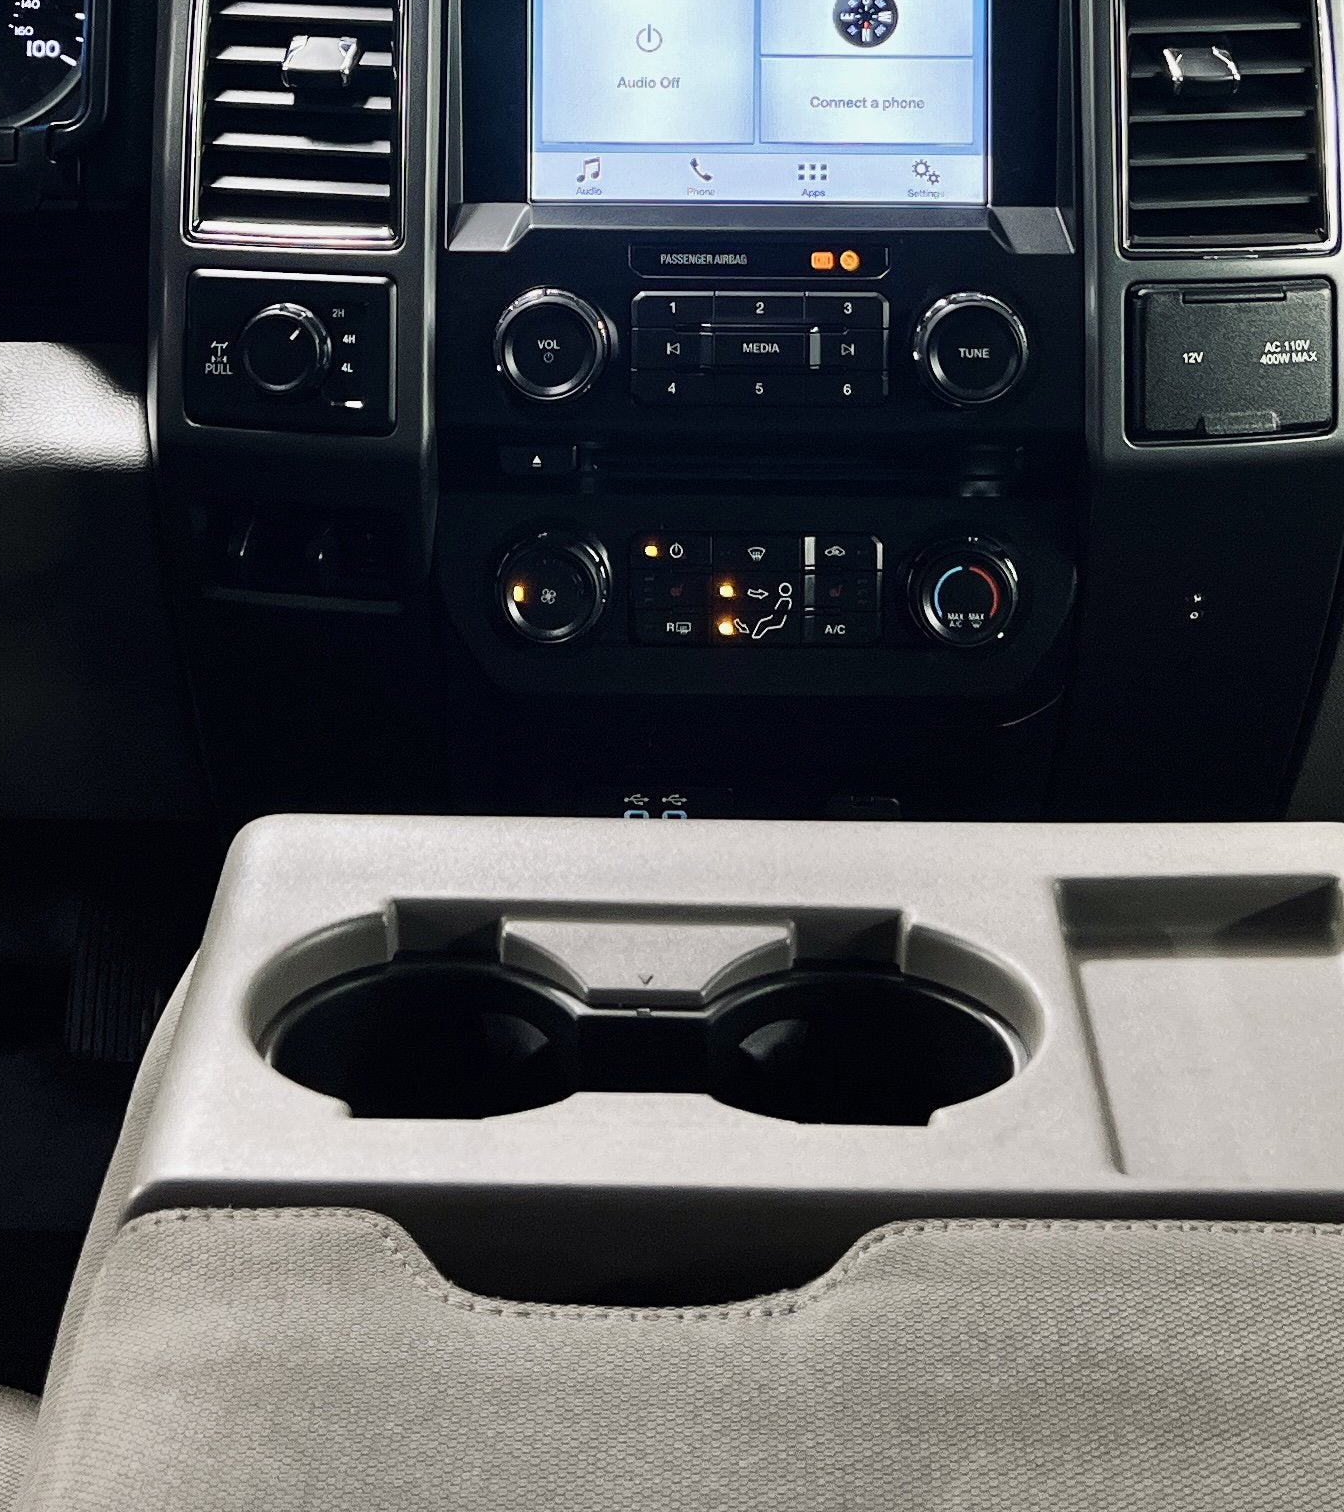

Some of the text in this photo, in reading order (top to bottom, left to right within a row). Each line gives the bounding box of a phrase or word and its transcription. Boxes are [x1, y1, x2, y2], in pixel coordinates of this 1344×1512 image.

[14, 26, 34, 37] 160
[26, 40, 61, 58] 100
[616, 76, 680, 89] Audio Off
[810, 96, 925, 111] Connect a phone
[575, 188, 602, 196] Audio
[687, 188, 715, 197] Phone
[802, 189, 825, 198] Apps
[907, 189, 944, 199] Settings
[660, 254, 748, 265] PASSENGER AIRBAG
[332, 309, 344, 318] 2H
[669, 302, 676, 314] 1
[756, 302, 764, 314] 2
[843, 302, 852, 314] 3
[342, 335, 356, 344] 4H
[537, 339, 560, 350] VOL
[742, 343, 780, 354] MEDIA
[1264, 340, 1310, 353] AC 110V
[959, 347, 990, 359] TUNE
[1182, 352, 1204, 364] 12V
[1260, 351, 1318, 365] 400W MAX
[205, 363, 233, 375] PULL
[341, 363, 353, 373] 4L
[667, 383, 676, 394] 4
[755, 383, 764, 395] 5
[843, 383, 852, 395] 6
[666, 622, 676, 633] R
[825, 624, 846, 635] A/C
